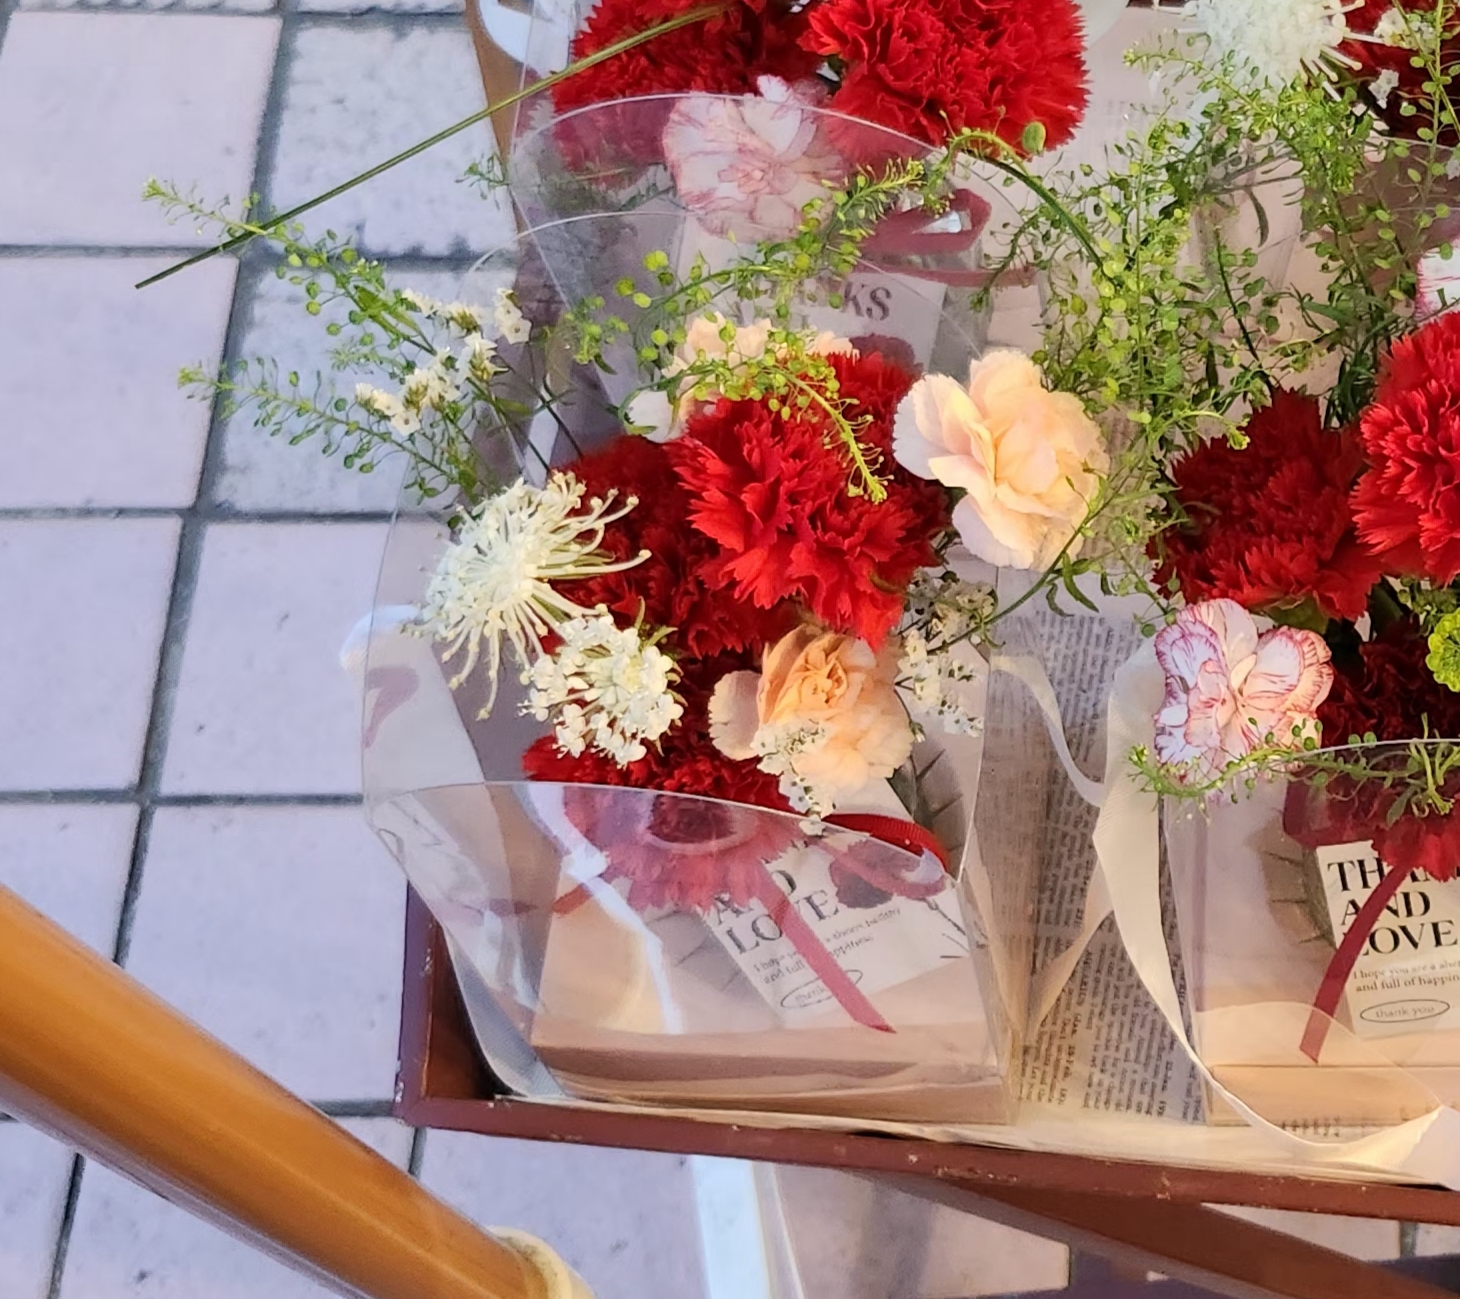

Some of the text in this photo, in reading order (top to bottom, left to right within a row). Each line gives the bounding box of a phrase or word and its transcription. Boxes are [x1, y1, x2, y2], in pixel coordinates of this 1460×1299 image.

[726, 890, 839, 954] LOE
[1343, 920, 1458, 956] OVE
[1356, 980, 1378, 993] and
[1381, 978, 1401, 990] full
[1375, 1006, 1435, 1018] thank you
